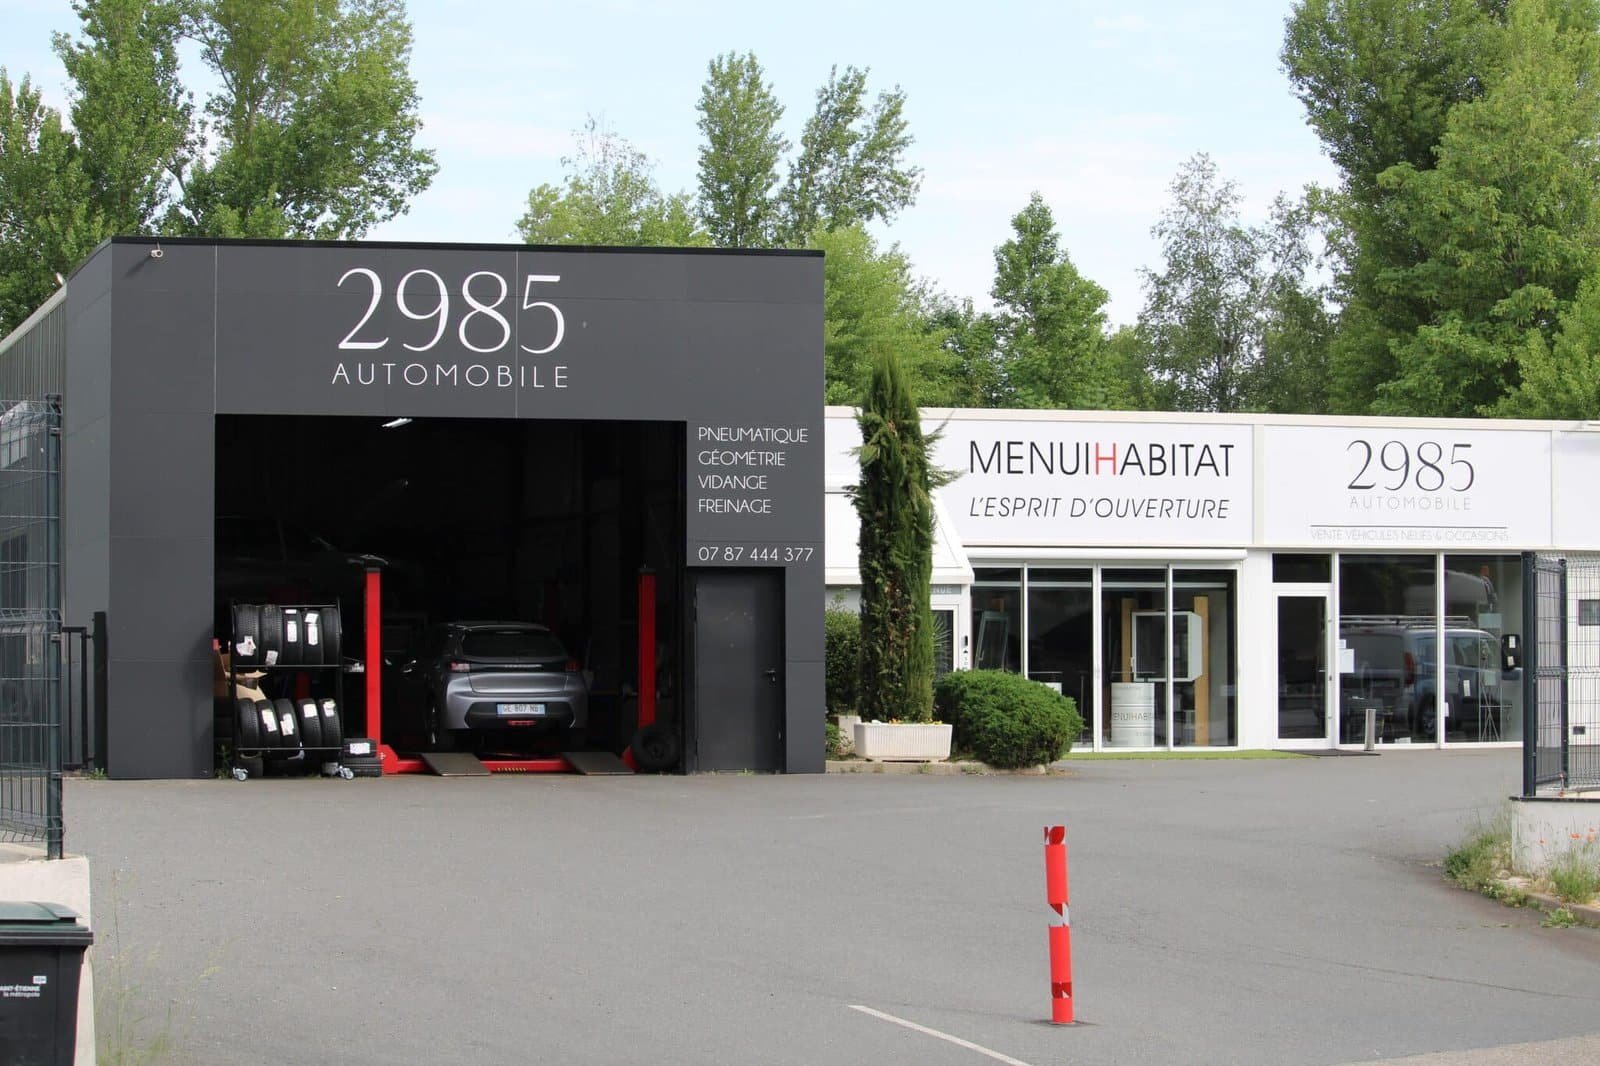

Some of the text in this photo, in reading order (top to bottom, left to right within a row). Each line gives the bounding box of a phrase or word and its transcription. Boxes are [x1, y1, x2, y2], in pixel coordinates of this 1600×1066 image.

[337, 267, 565, 354] 2985
[332, 363, 568, 388] AUTOMOBILE
[698, 426, 809, 444] PNEUMATIQUE
[698, 448, 786, 466] GÉOMÉTRIE
[969, 440, 1234, 477] MENUIHABITAT
[1346, 439, 1475, 492] 2985
[698, 474, 768, 490] VIDANGE
[698, 498, 772, 514] FREINAGE
[969, 497, 1230, 519] L'ESPRIT D'OUVERTURE
[1349, 496, 1473, 511] AUTOMOBILE
[1310, 529, 1342, 540] VENTE
[1401, 530, 1432, 541] NEUFS
[1446, 531, 1509, 542] OCCASIONS
[698, 546, 814, 562] 07 87 444 377
